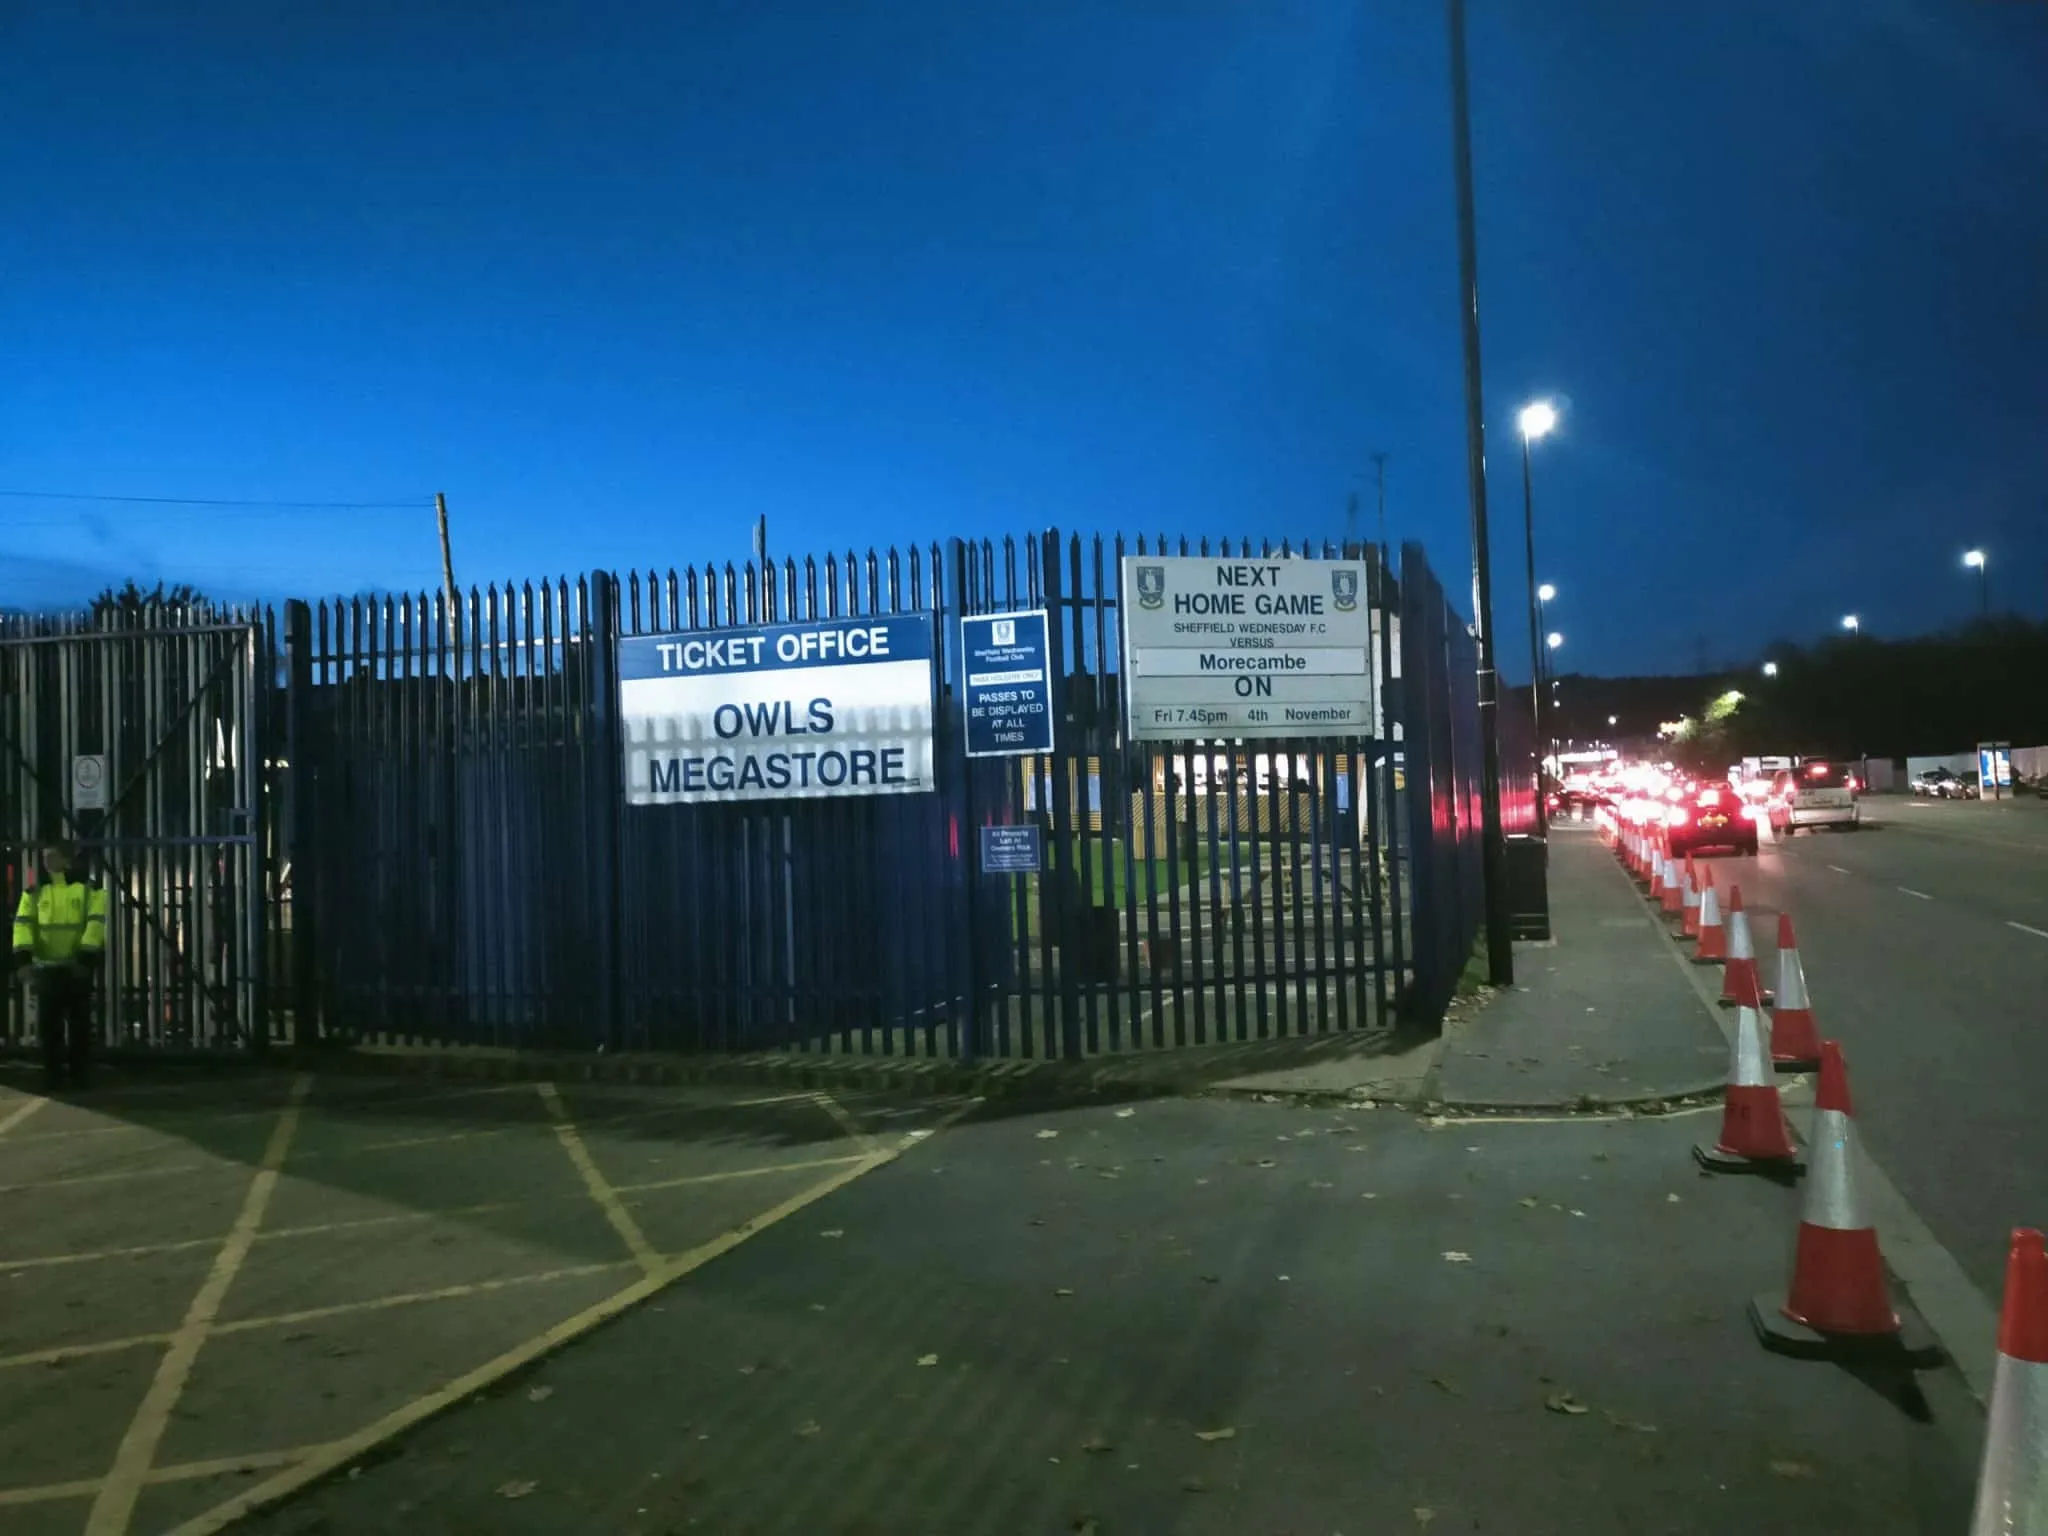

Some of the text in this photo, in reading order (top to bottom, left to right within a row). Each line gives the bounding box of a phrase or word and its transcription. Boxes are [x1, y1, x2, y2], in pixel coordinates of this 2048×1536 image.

[1216, 565, 1281, 587] NEXT
[1174, 593, 1324, 616] HOME GAME
[1173, 623, 1235, 633] SHEFFIELD
[1239, 623, 1306, 633] WEDNESDAY
[656, 626, 889, 671] TICKET OFFICE
[1229, 637, 1275, 648] VERSUS
[1199, 653, 1307, 670] Morecambe
[1234, 675, 1272, 697] ON
[978, 689, 1035, 703] PASSES TO
[714, 697, 834, 738] OWLS
[971, 703, 1044, 717] BE DISPLAYED
[1154, 707, 1352, 725] Fri 7.45pm 4th November
[991, 717, 1025, 729] AT ALL
[994, 731, 1025, 743] TIMES
[650, 748, 905, 793] MEGASTORE
